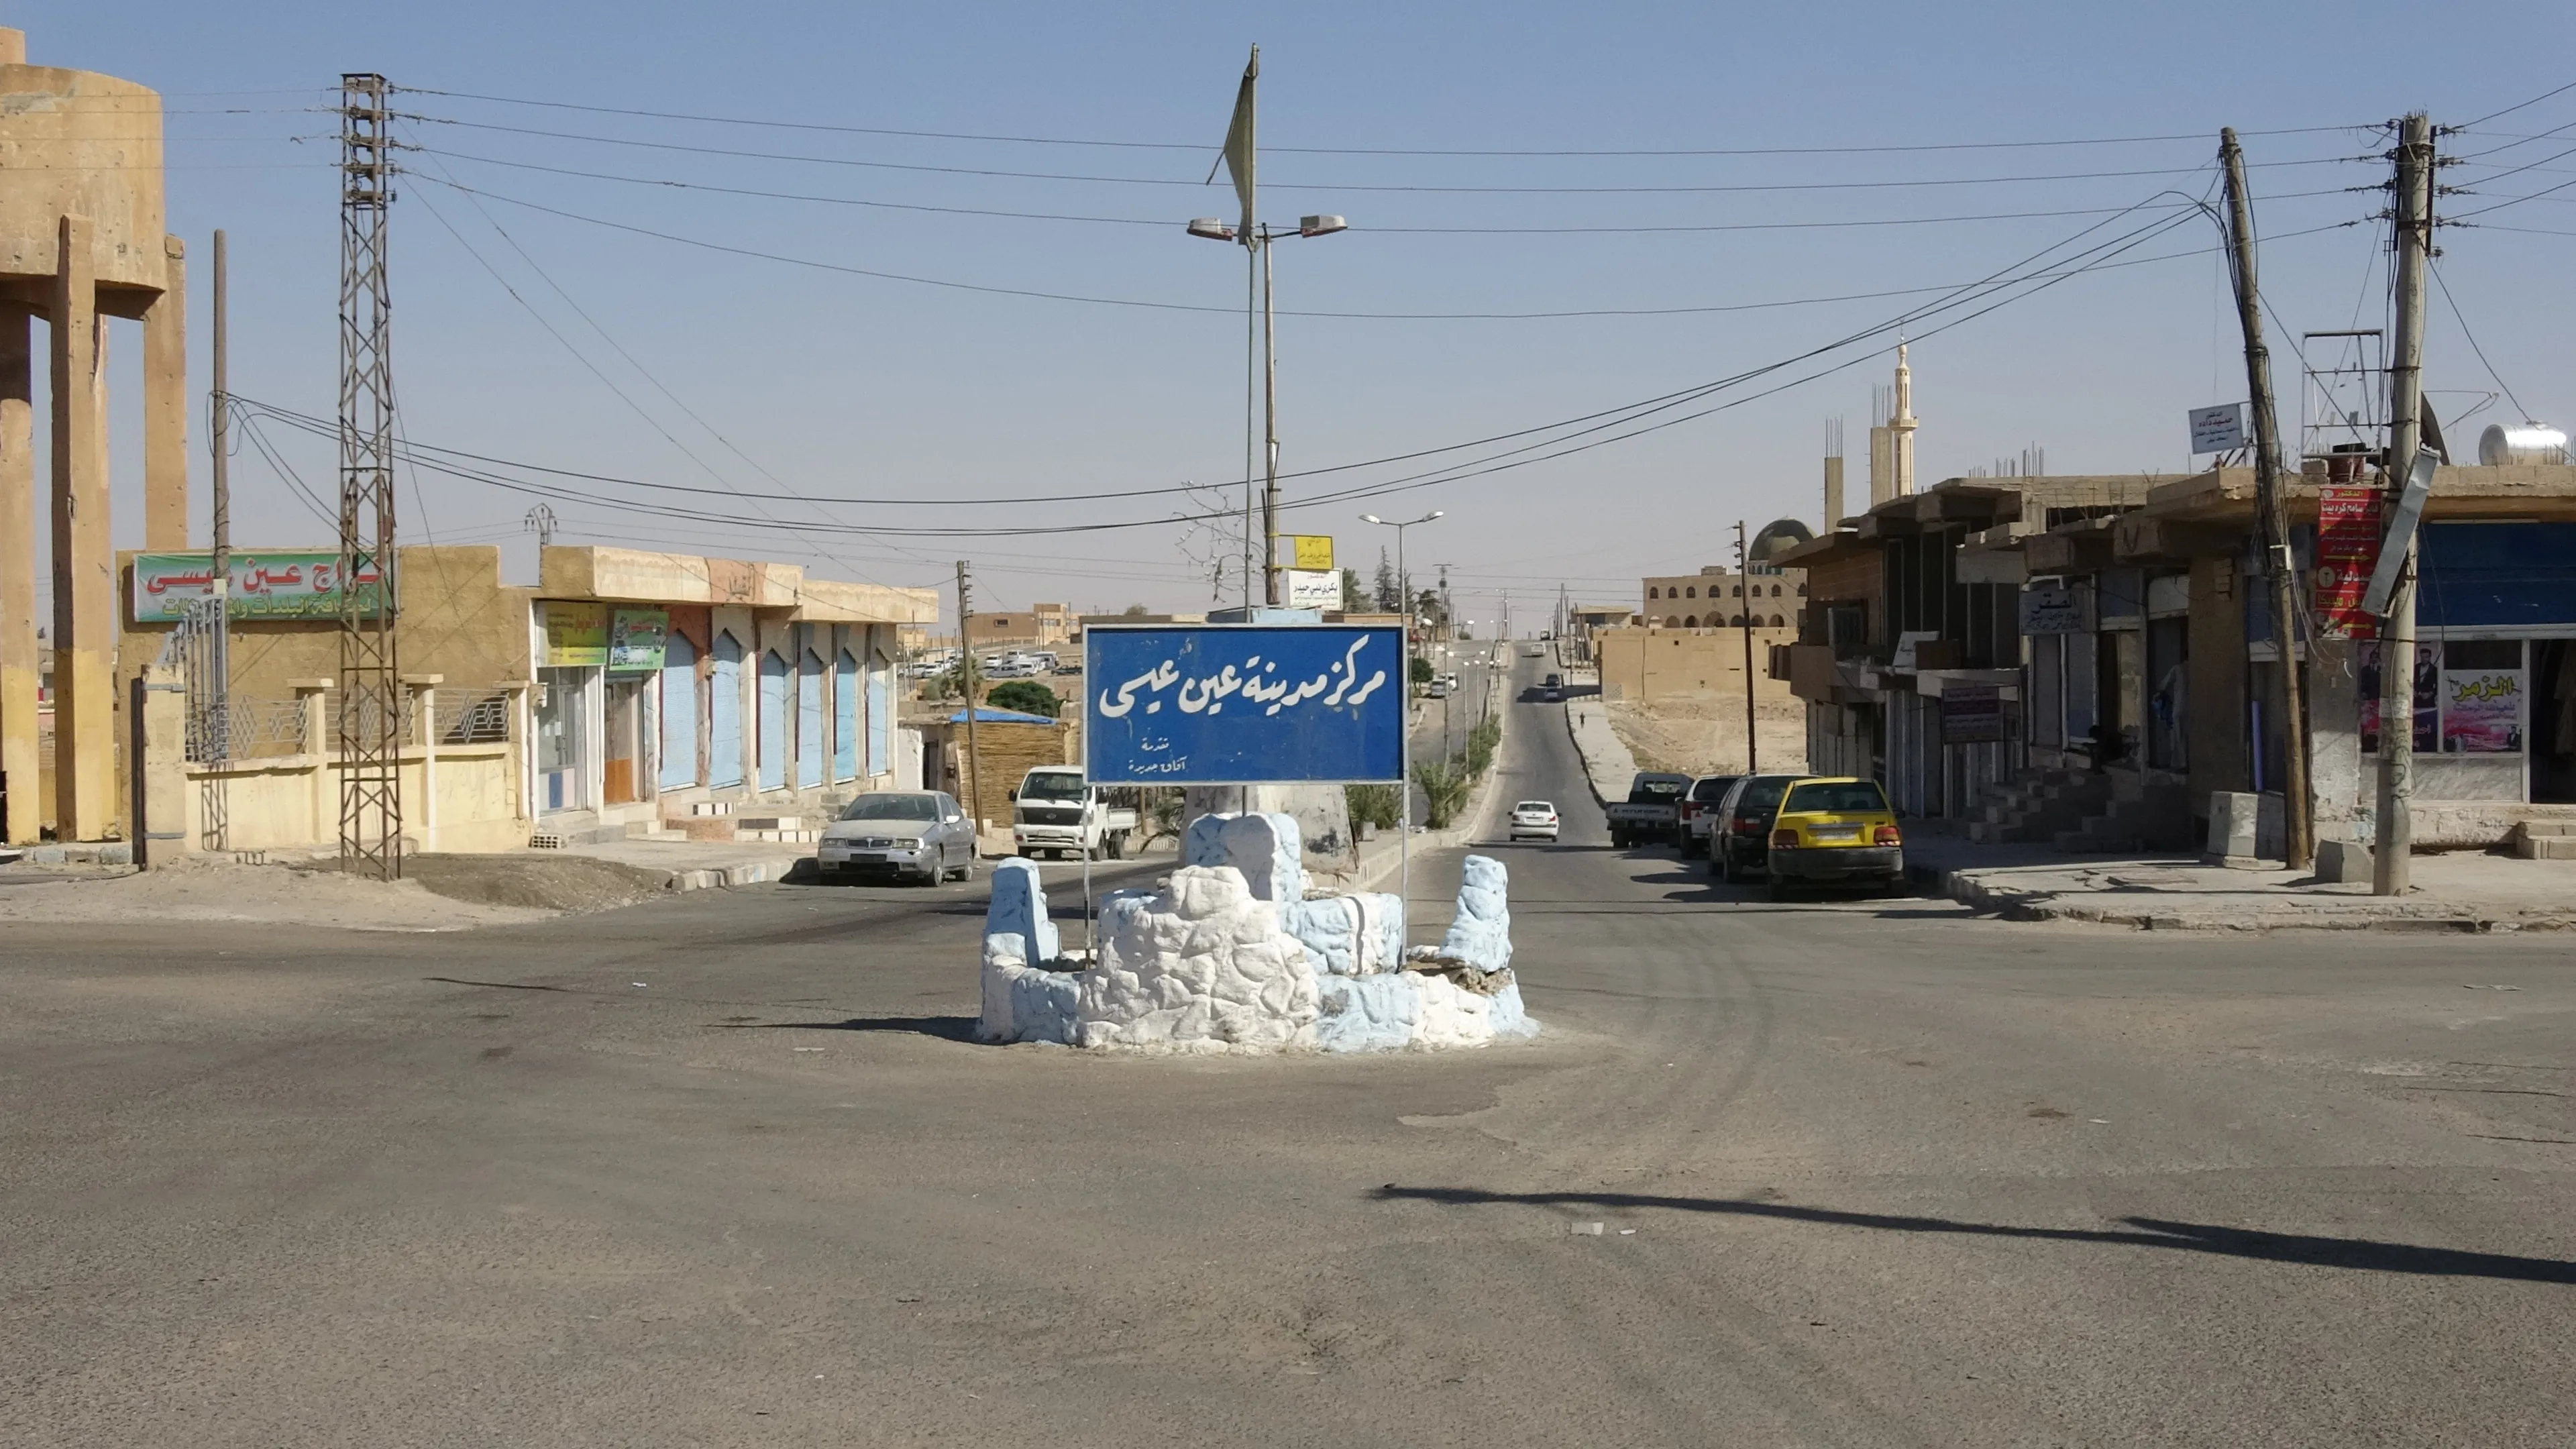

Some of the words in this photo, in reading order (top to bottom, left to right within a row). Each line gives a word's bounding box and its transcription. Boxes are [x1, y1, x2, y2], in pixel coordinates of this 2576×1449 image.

[147, 567, 234, 595] يسى
[244, 556, 303, 595] عين
[252, 596, 309, 619] البلدات
[1242, 655, 1327, 716] مدينة
[1323, 634, 1386, 706] مركز
[1099, 659, 1179, 718] عيسى
[1178, 664, 1242, 715] عين
[1141, 737, 1169, 751] تقدمة
[1128, 759, 1158, 775] جديدة
[1160, 755, 1188, 773] آفاق
